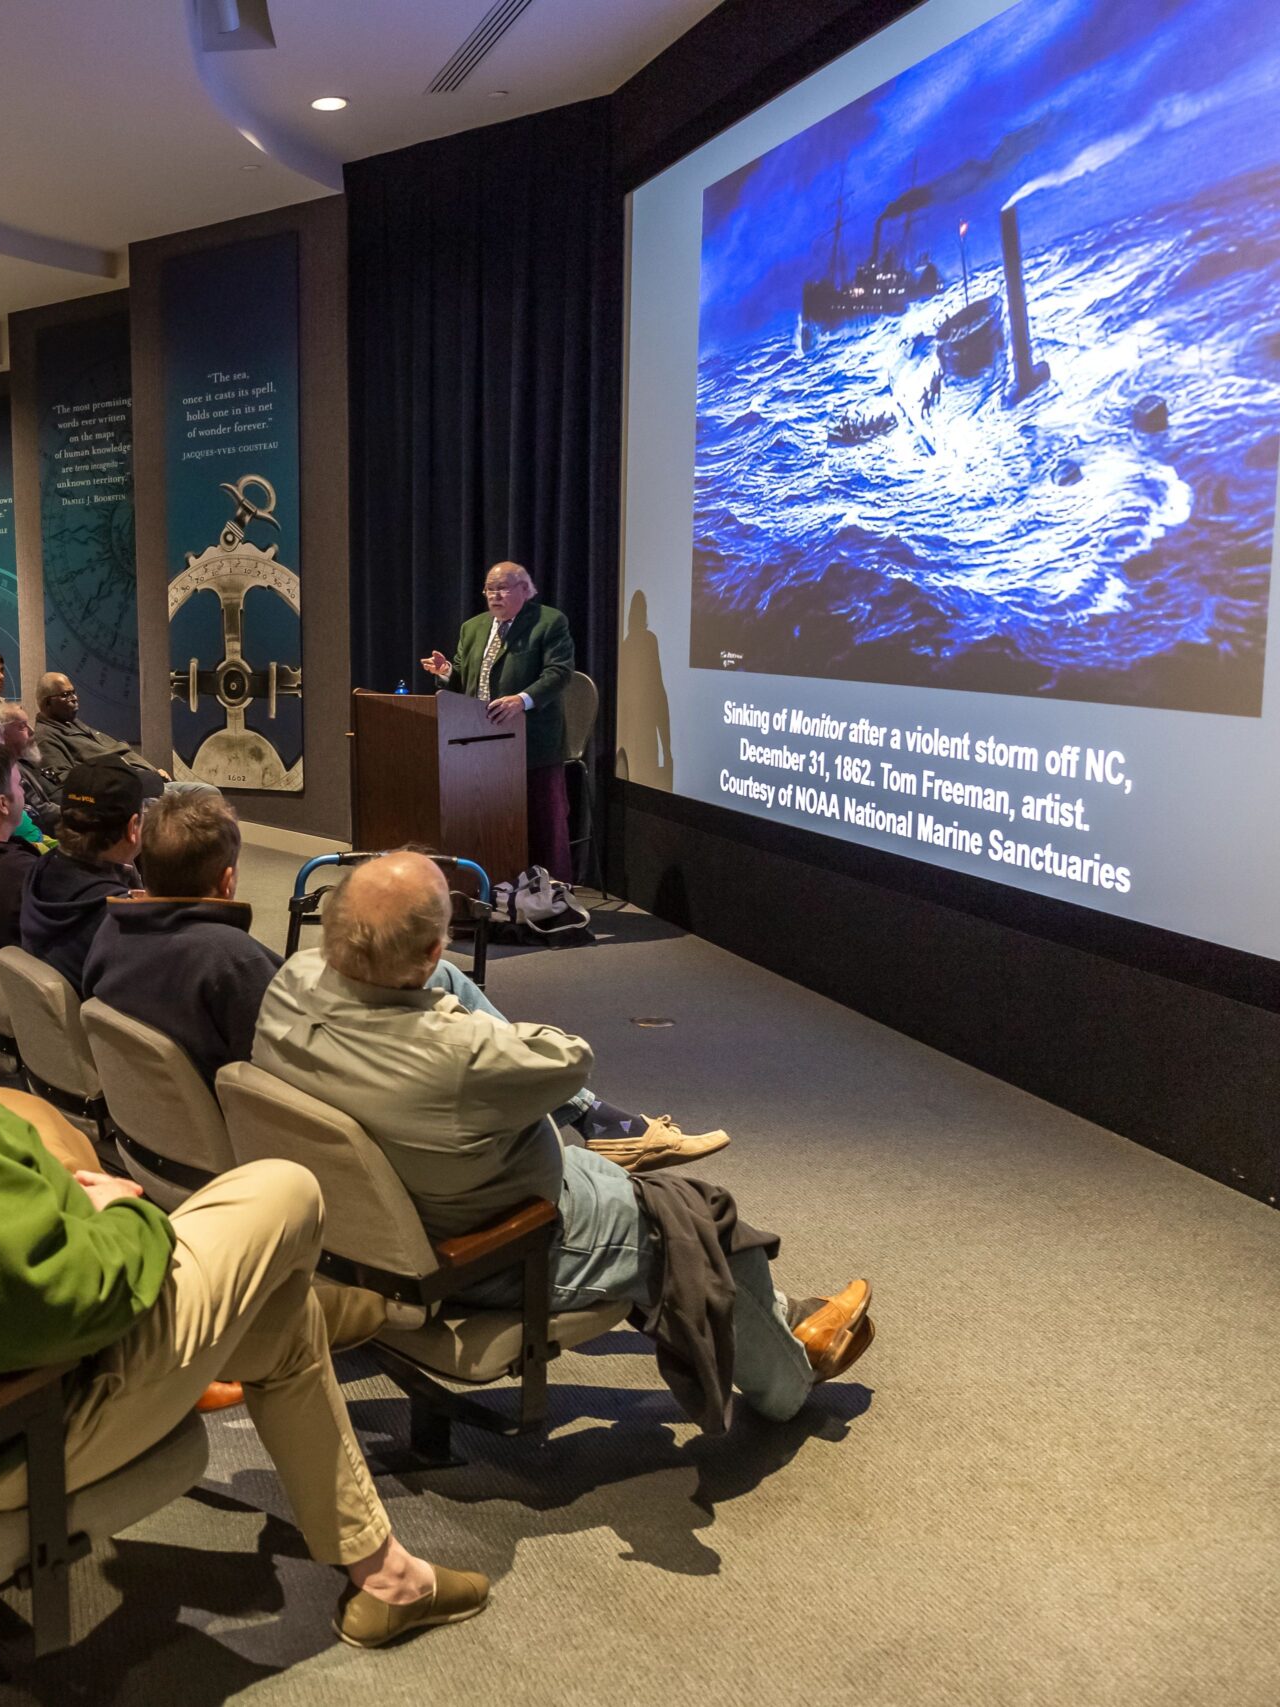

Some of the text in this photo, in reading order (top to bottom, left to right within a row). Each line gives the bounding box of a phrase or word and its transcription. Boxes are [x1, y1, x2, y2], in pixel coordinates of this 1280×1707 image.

[182, 396, 203, 405] once
[205, 393, 212, 402] it
[214, 391, 235, 400] casts
[238, 388, 249, 397] its
[73, 403, 90, 413] most
[92, 398, 132, 413] promising
[186, 403, 272, 421] holds one in its net
[58, 414, 126, 429] words ever written
[69, 431, 115, 443] on the maps
[187, 427, 197, 438] of
[198, 424, 232, 436] wonder
[54, 442, 132, 459] of human knowledge
[182, 441, 279, 460] JACQUES-YVES COUSTEAU
[62, 465, 73, 474] are
[56, 478, 91, 488] unknown
[723, 700, 1132, 794] Sinking of Monitor after a violent storm off NC,
[740, 738, 1090, 831] December 31, 1862. Tom Freeman, artist.
[720, 769, 1131, 893] Courtesy of NOAA National Marine Sanctuaries
